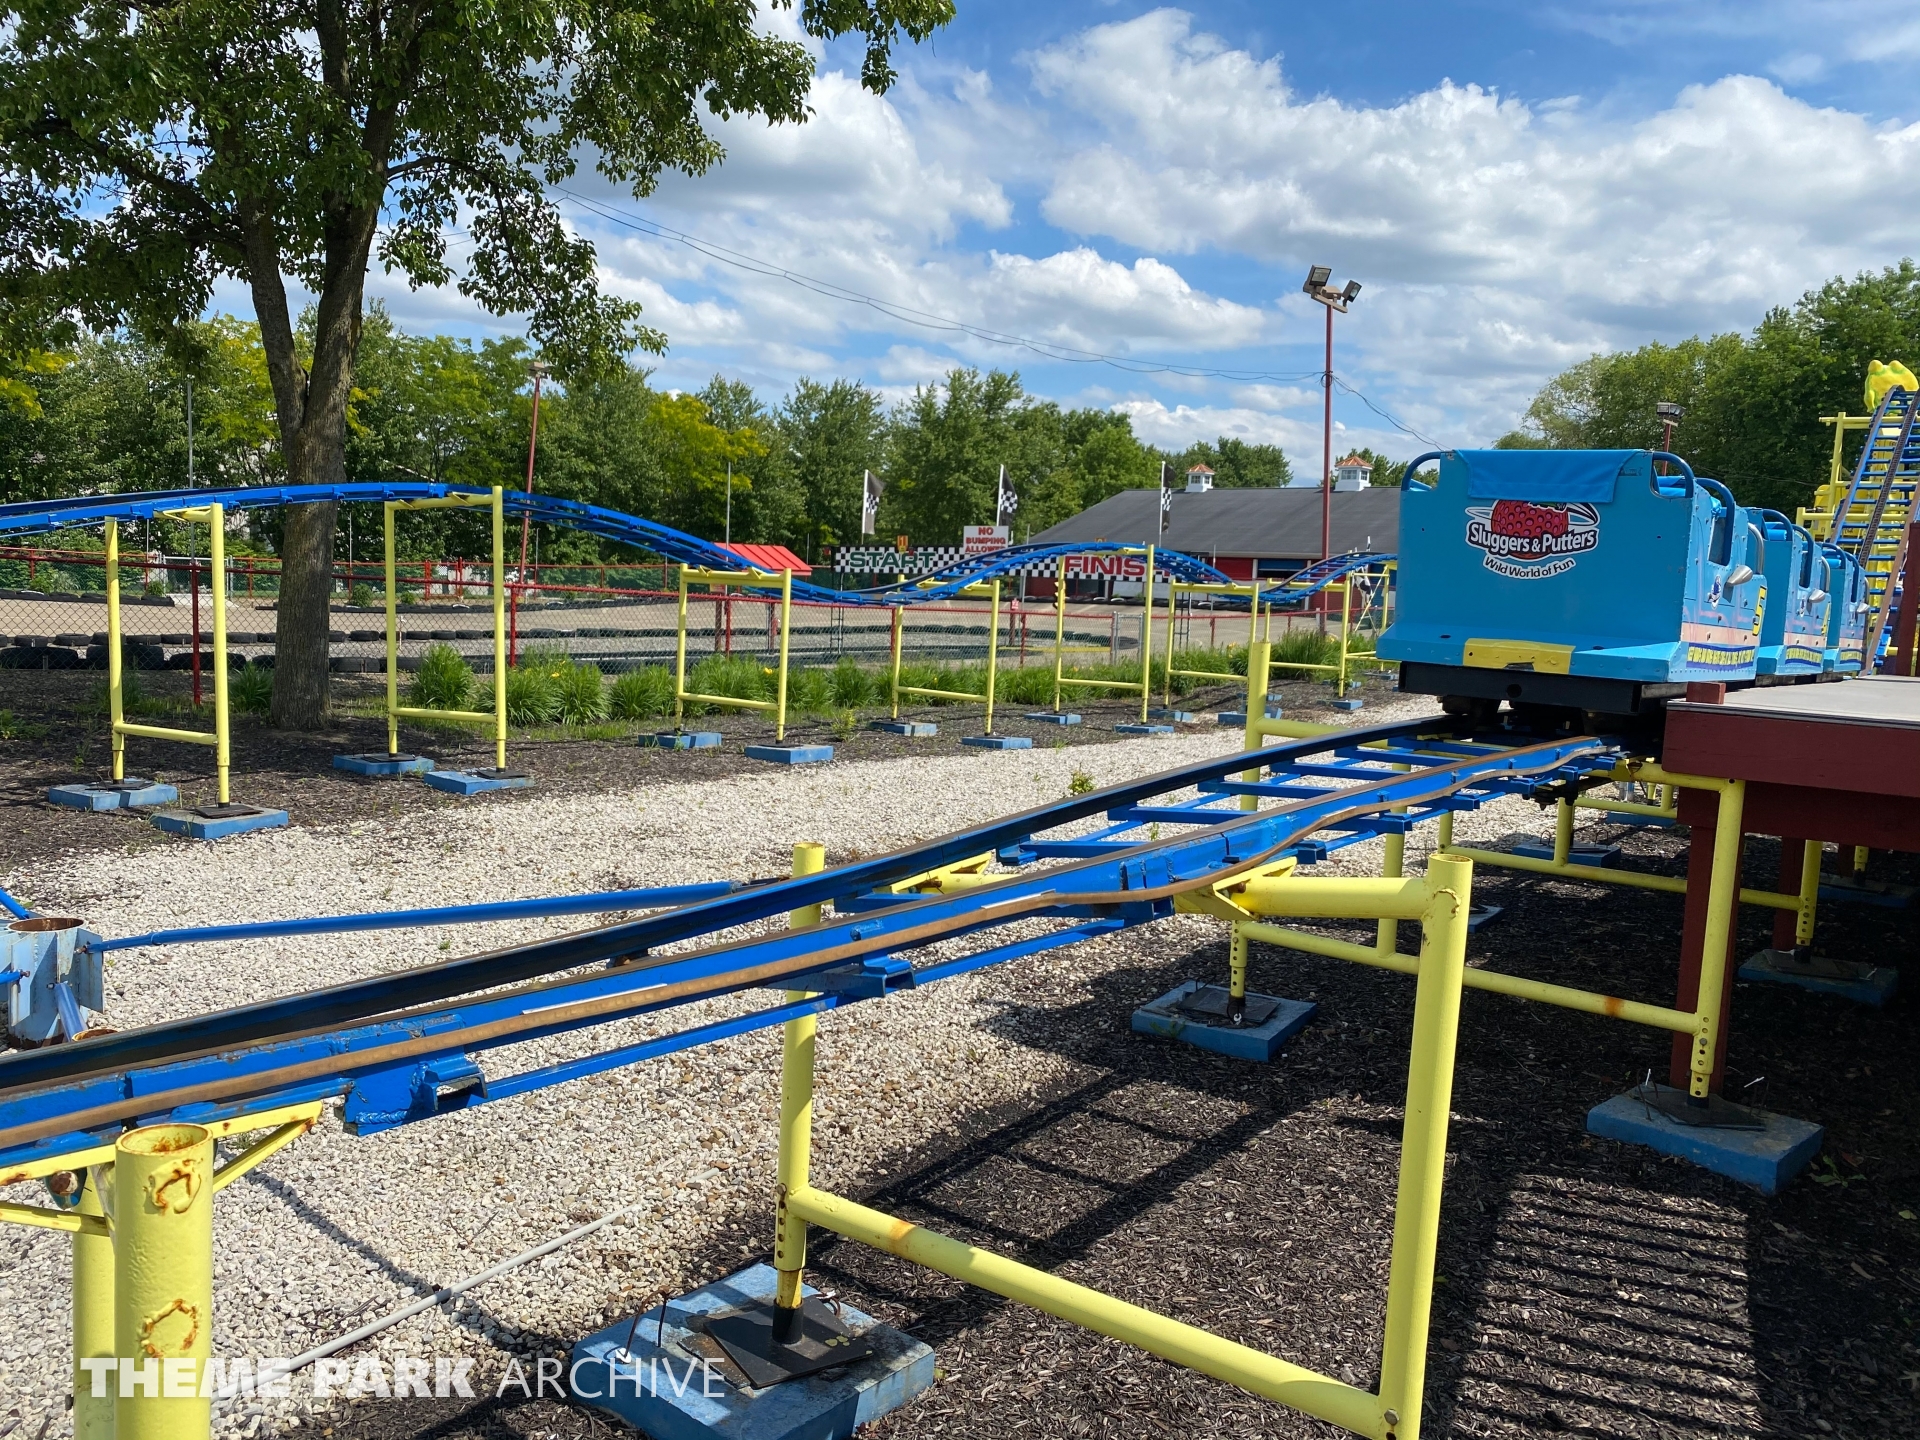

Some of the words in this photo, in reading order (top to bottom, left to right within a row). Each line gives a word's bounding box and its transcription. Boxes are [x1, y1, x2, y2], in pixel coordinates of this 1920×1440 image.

[978, 527, 994, 535] NO
[1470, 523, 1530, 554] Sluggers
[1531, 538, 1541, 552] &
[1542, 531, 1594, 552] Putters
[965, 545, 1005, 553] ALLOWE
[966, 537, 1006, 545] BUMPING
[850, 551, 935, 568] START
[1485, 556, 1507, 574] Wild
[1509, 565, 1540, 578] World
[1542, 566, 1552, 577] of
[1553, 559, 1575, 573] Fun
[1752, 585, 1767, 637] 5
